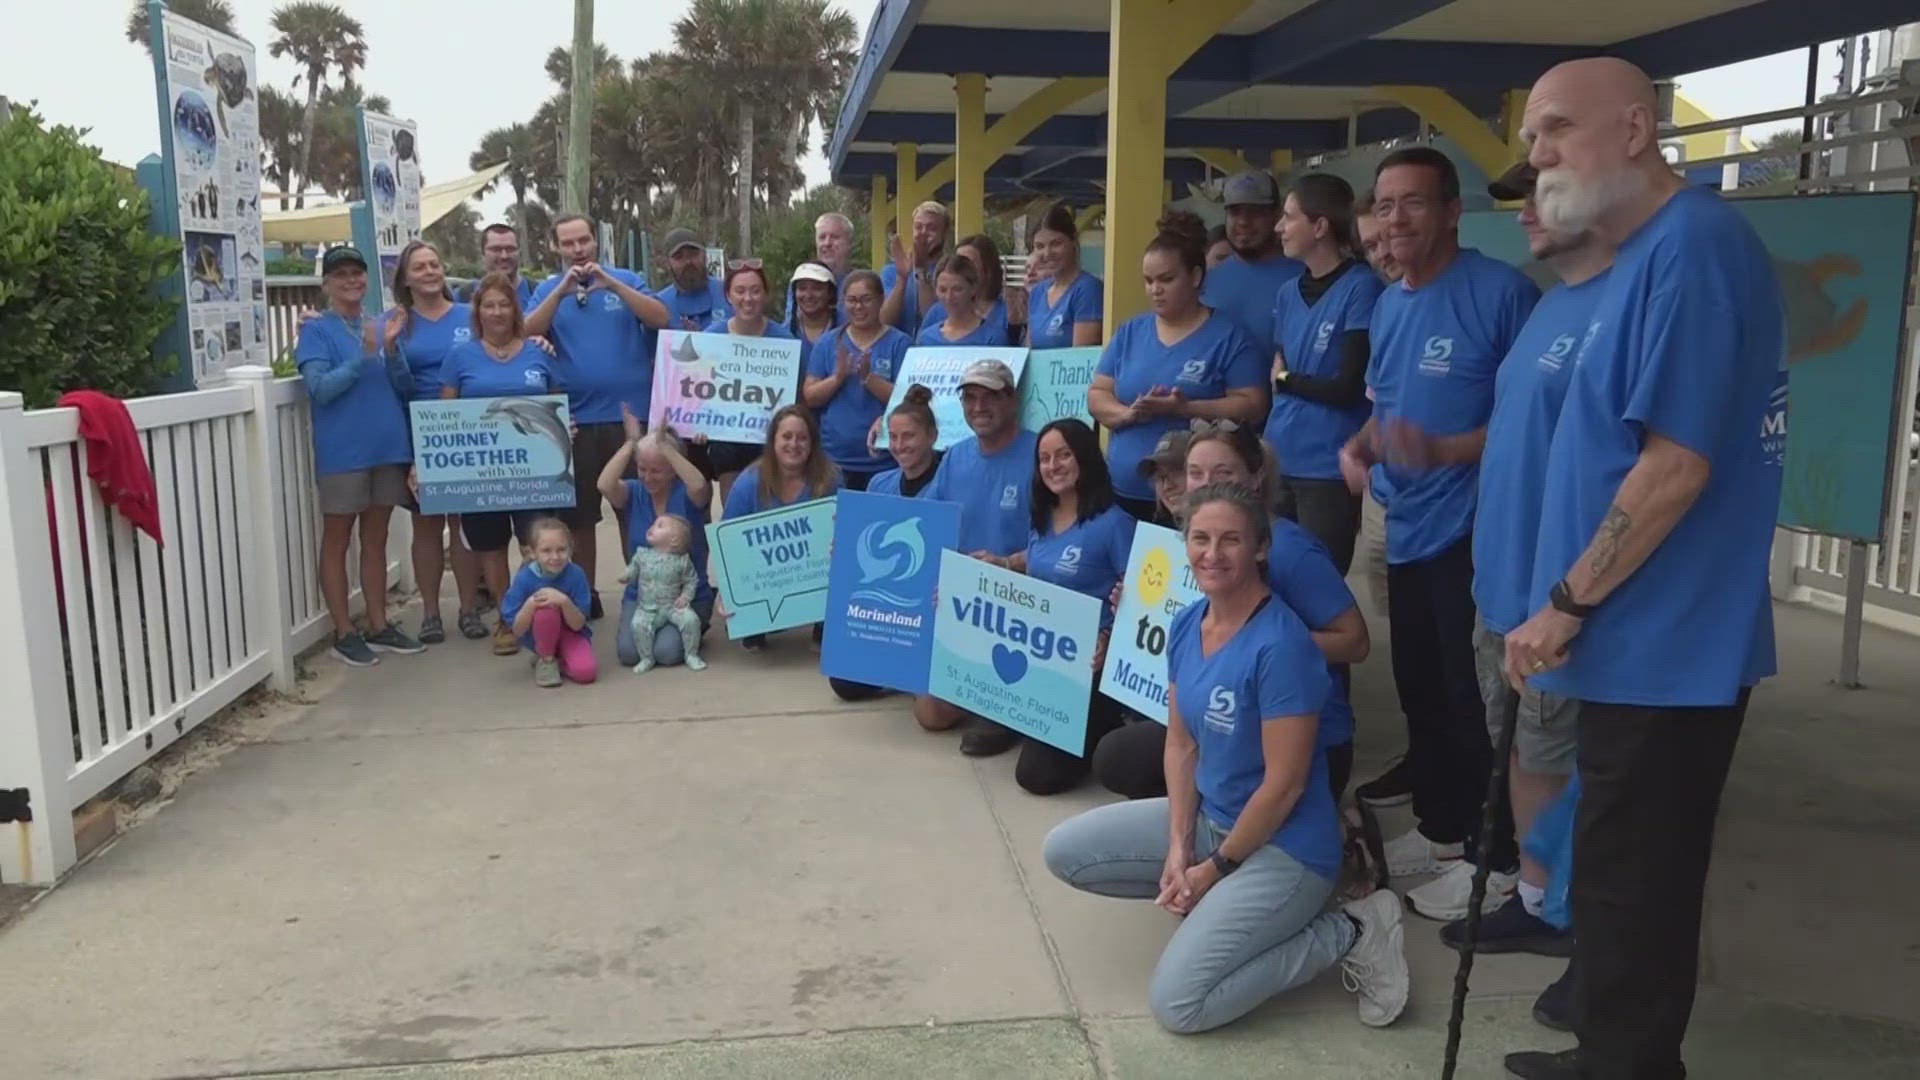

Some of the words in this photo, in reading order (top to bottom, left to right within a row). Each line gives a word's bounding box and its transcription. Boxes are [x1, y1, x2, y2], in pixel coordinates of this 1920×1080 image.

[733, 343, 757, 358] The
[761, 347, 791, 360] new
[720, 363, 741, 372] era
[745, 361, 789, 378] begins
[907, 374, 948, 385] WHERE
[1049, 360, 1095, 387] Thank
[680, 376, 784, 411] today
[1054, 392, 1087, 417] You!
[418, 411, 438, 421] We
[440, 410, 460, 420] are
[419, 421, 459, 432] excited
[461, 420, 478, 431] for
[480, 421, 499, 430] our
[664, 407, 770, 430] Marinelan
[422, 432, 500, 449] JOURNEY
[421, 448, 528, 469] TOGETHER
[477, 466, 505, 479] with
[508, 466, 531, 477] You
[509, 479, 550, 490] Florida
[476, 496, 485, 506] &
[488, 493, 527, 506] Flagler
[531, 491, 573, 505] County
[742, 515, 813, 547] THANK
[761, 540, 811, 566] YOU!
[977, 572, 990, 593] it
[993, 580, 1036, 610] takes
[1040, 600, 1050, 614] a
[846, 604, 922, 629] Marineland
[952, 594, 1078, 661] village
[1136, 614, 1166, 656] to
[1113, 659, 1170, 708] Marine
[955, 686, 964, 698] &
[966, 689, 1005, 714] Flagler
[1008, 705, 1052, 735] County
[964, 673, 1024, 707] Augustine,
[1027, 698, 1070, 724] Florida
